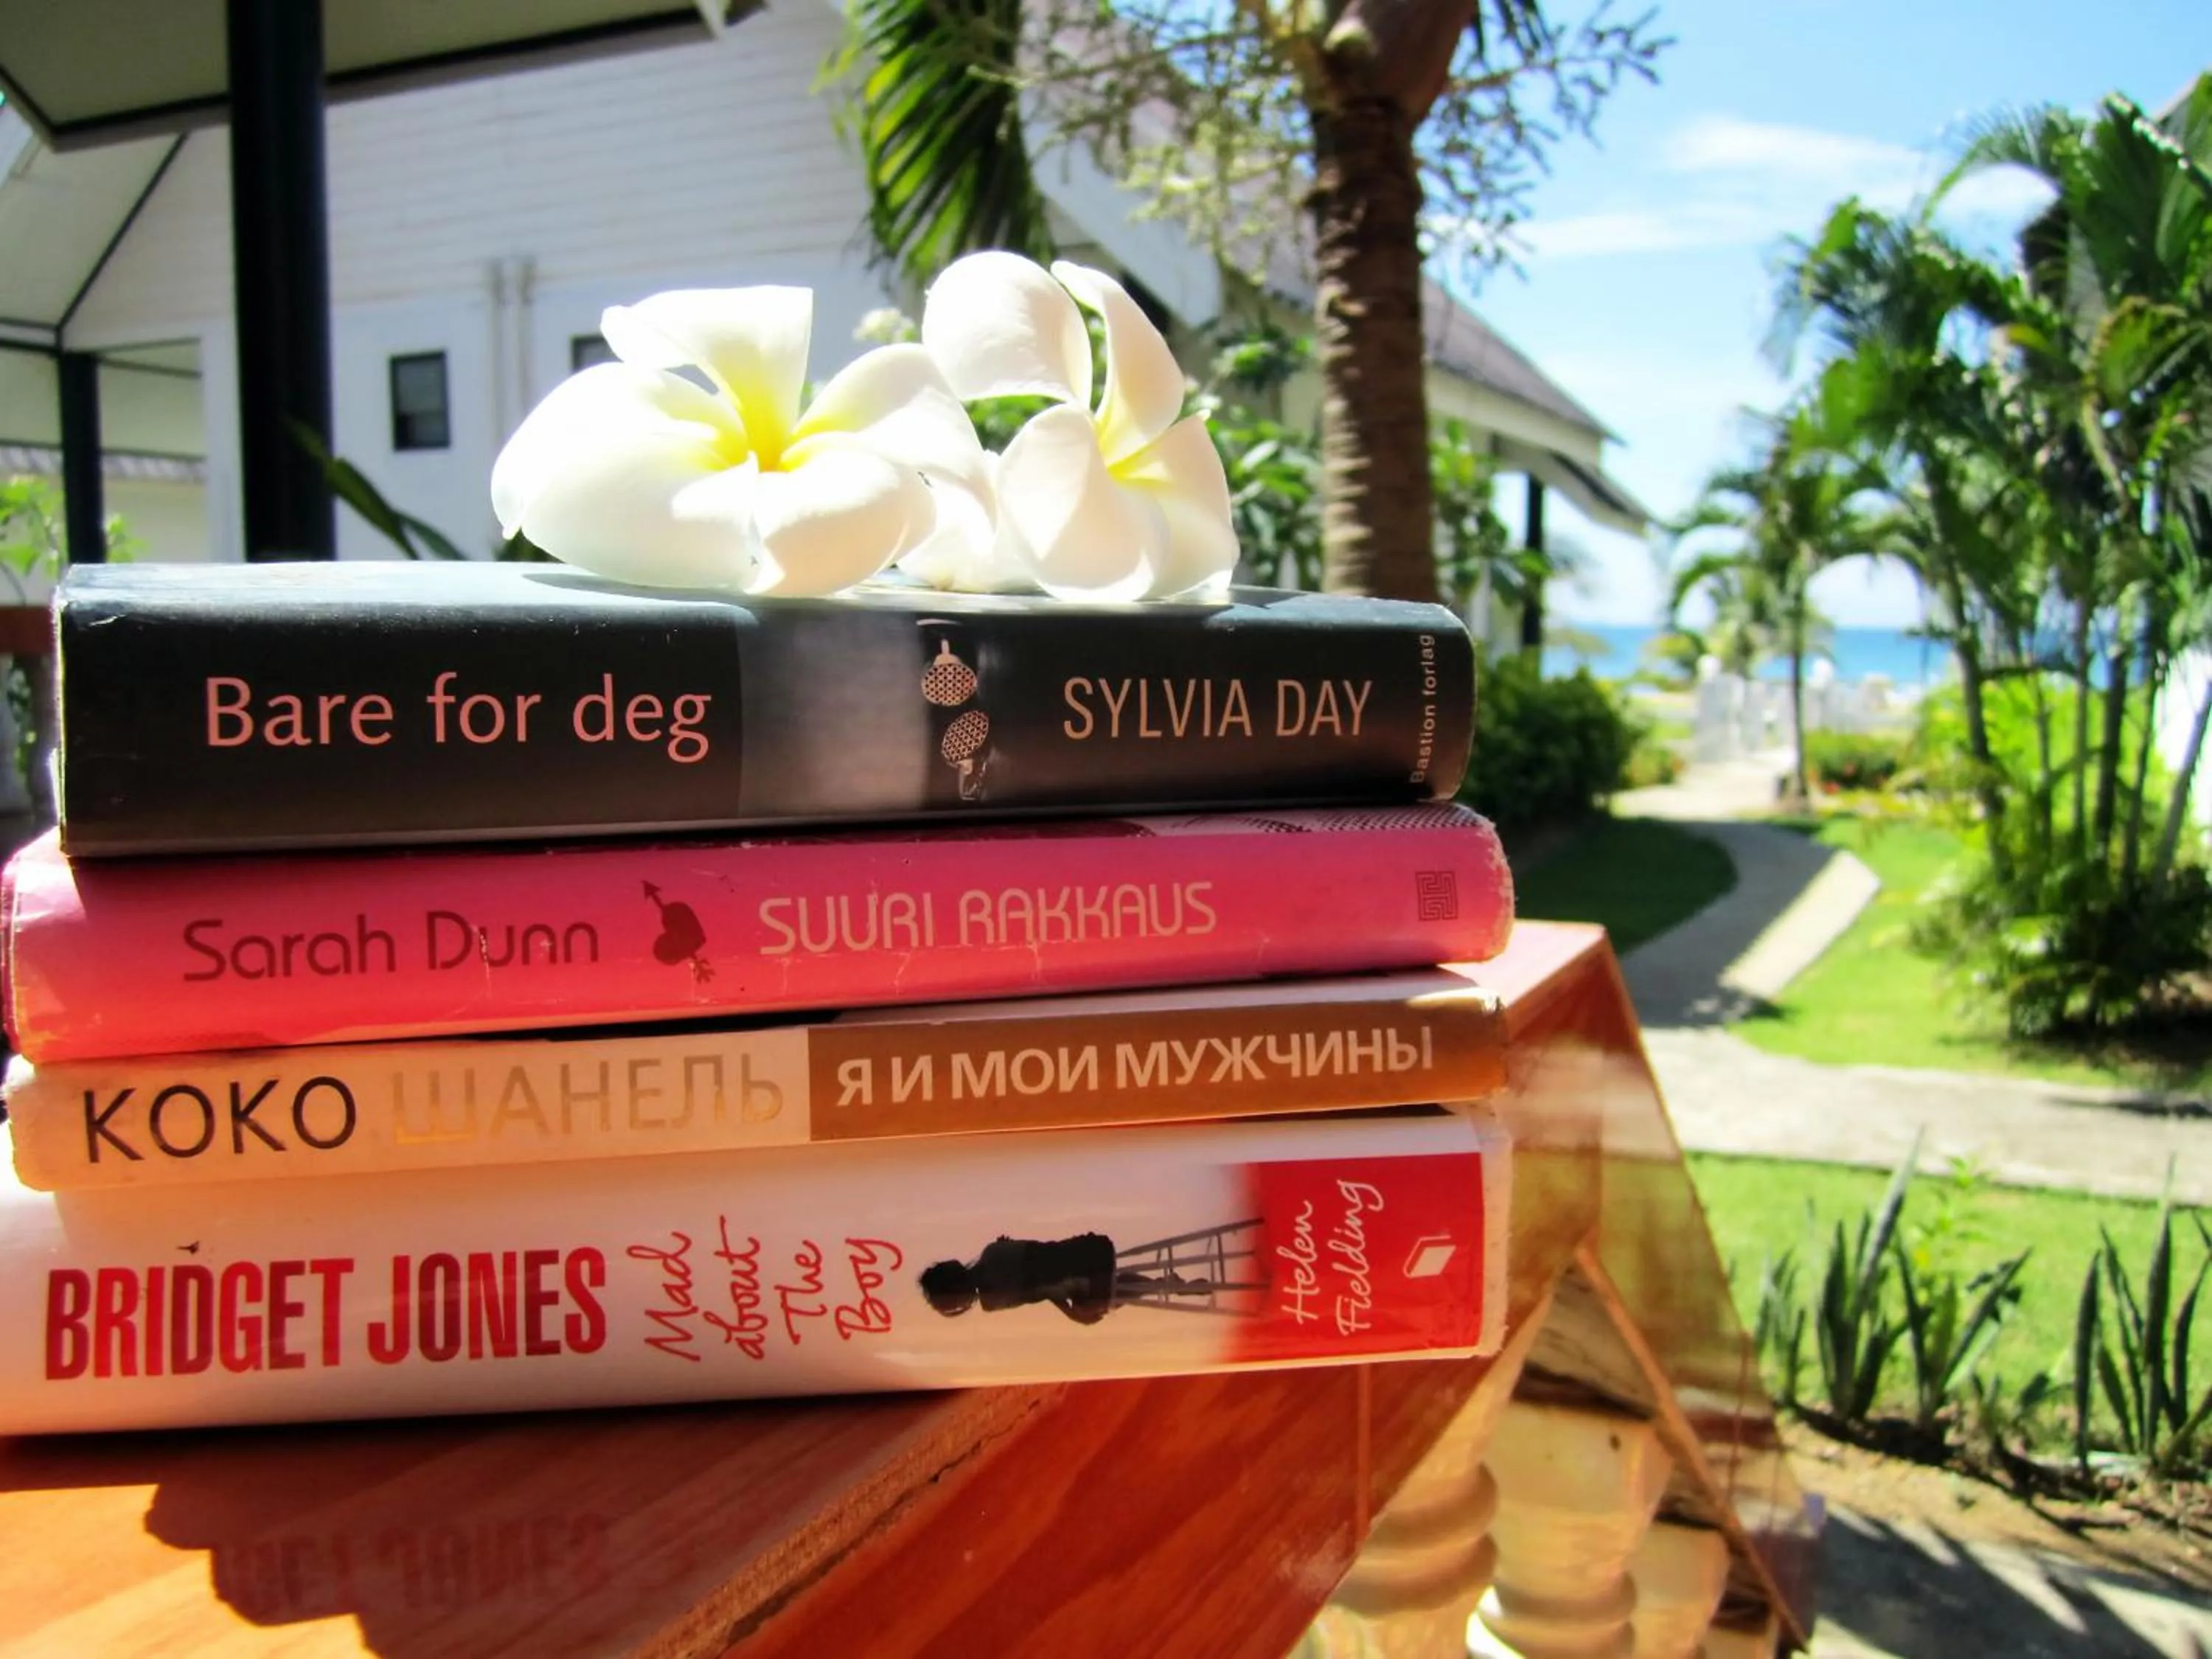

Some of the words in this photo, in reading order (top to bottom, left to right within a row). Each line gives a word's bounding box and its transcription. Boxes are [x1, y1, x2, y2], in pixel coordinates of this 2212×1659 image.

[1062, 675, 1252, 740] SYLVIA
[1276, 679, 1372, 737] DAY
[1419, 634, 1437, 695] forlag
[206, 675, 394, 746] Bare
[426, 672, 542, 743] for
[573, 673, 713, 763] deg
[1410, 705, 1436, 783] Bastion
[183, 914, 397, 981] Sarah
[426, 911, 599, 970] Dunn
[759, 893, 934, 955] SUURI
[959, 882, 1217, 945] RAKKAUS
[82, 1075, 357, 1164] КОКО
[391, 1053, 784, 1146] ШАНЕЛЬ
[836, 1059, 872, 1107] Я
[891, 1055, 933, 1104] И
[950, 1046, 1099, 1099] МОИ
[1116, 1026, 1433, 1089] МУЖЧИНЫ
[627, 1231, 701, 1362] Mad
[703, 1215, 768, 1360] about
[774, 1239, 828, 1345] The
[835, 1239, 902, 1340] Boy
[1276, 1200, 1320, 1324] Helen
[1327, 1179, 1384, 1336] Fielding
[45, 1257, 355, 1380] BRIDGET
[367, 1246, 607, 1365] JONES
